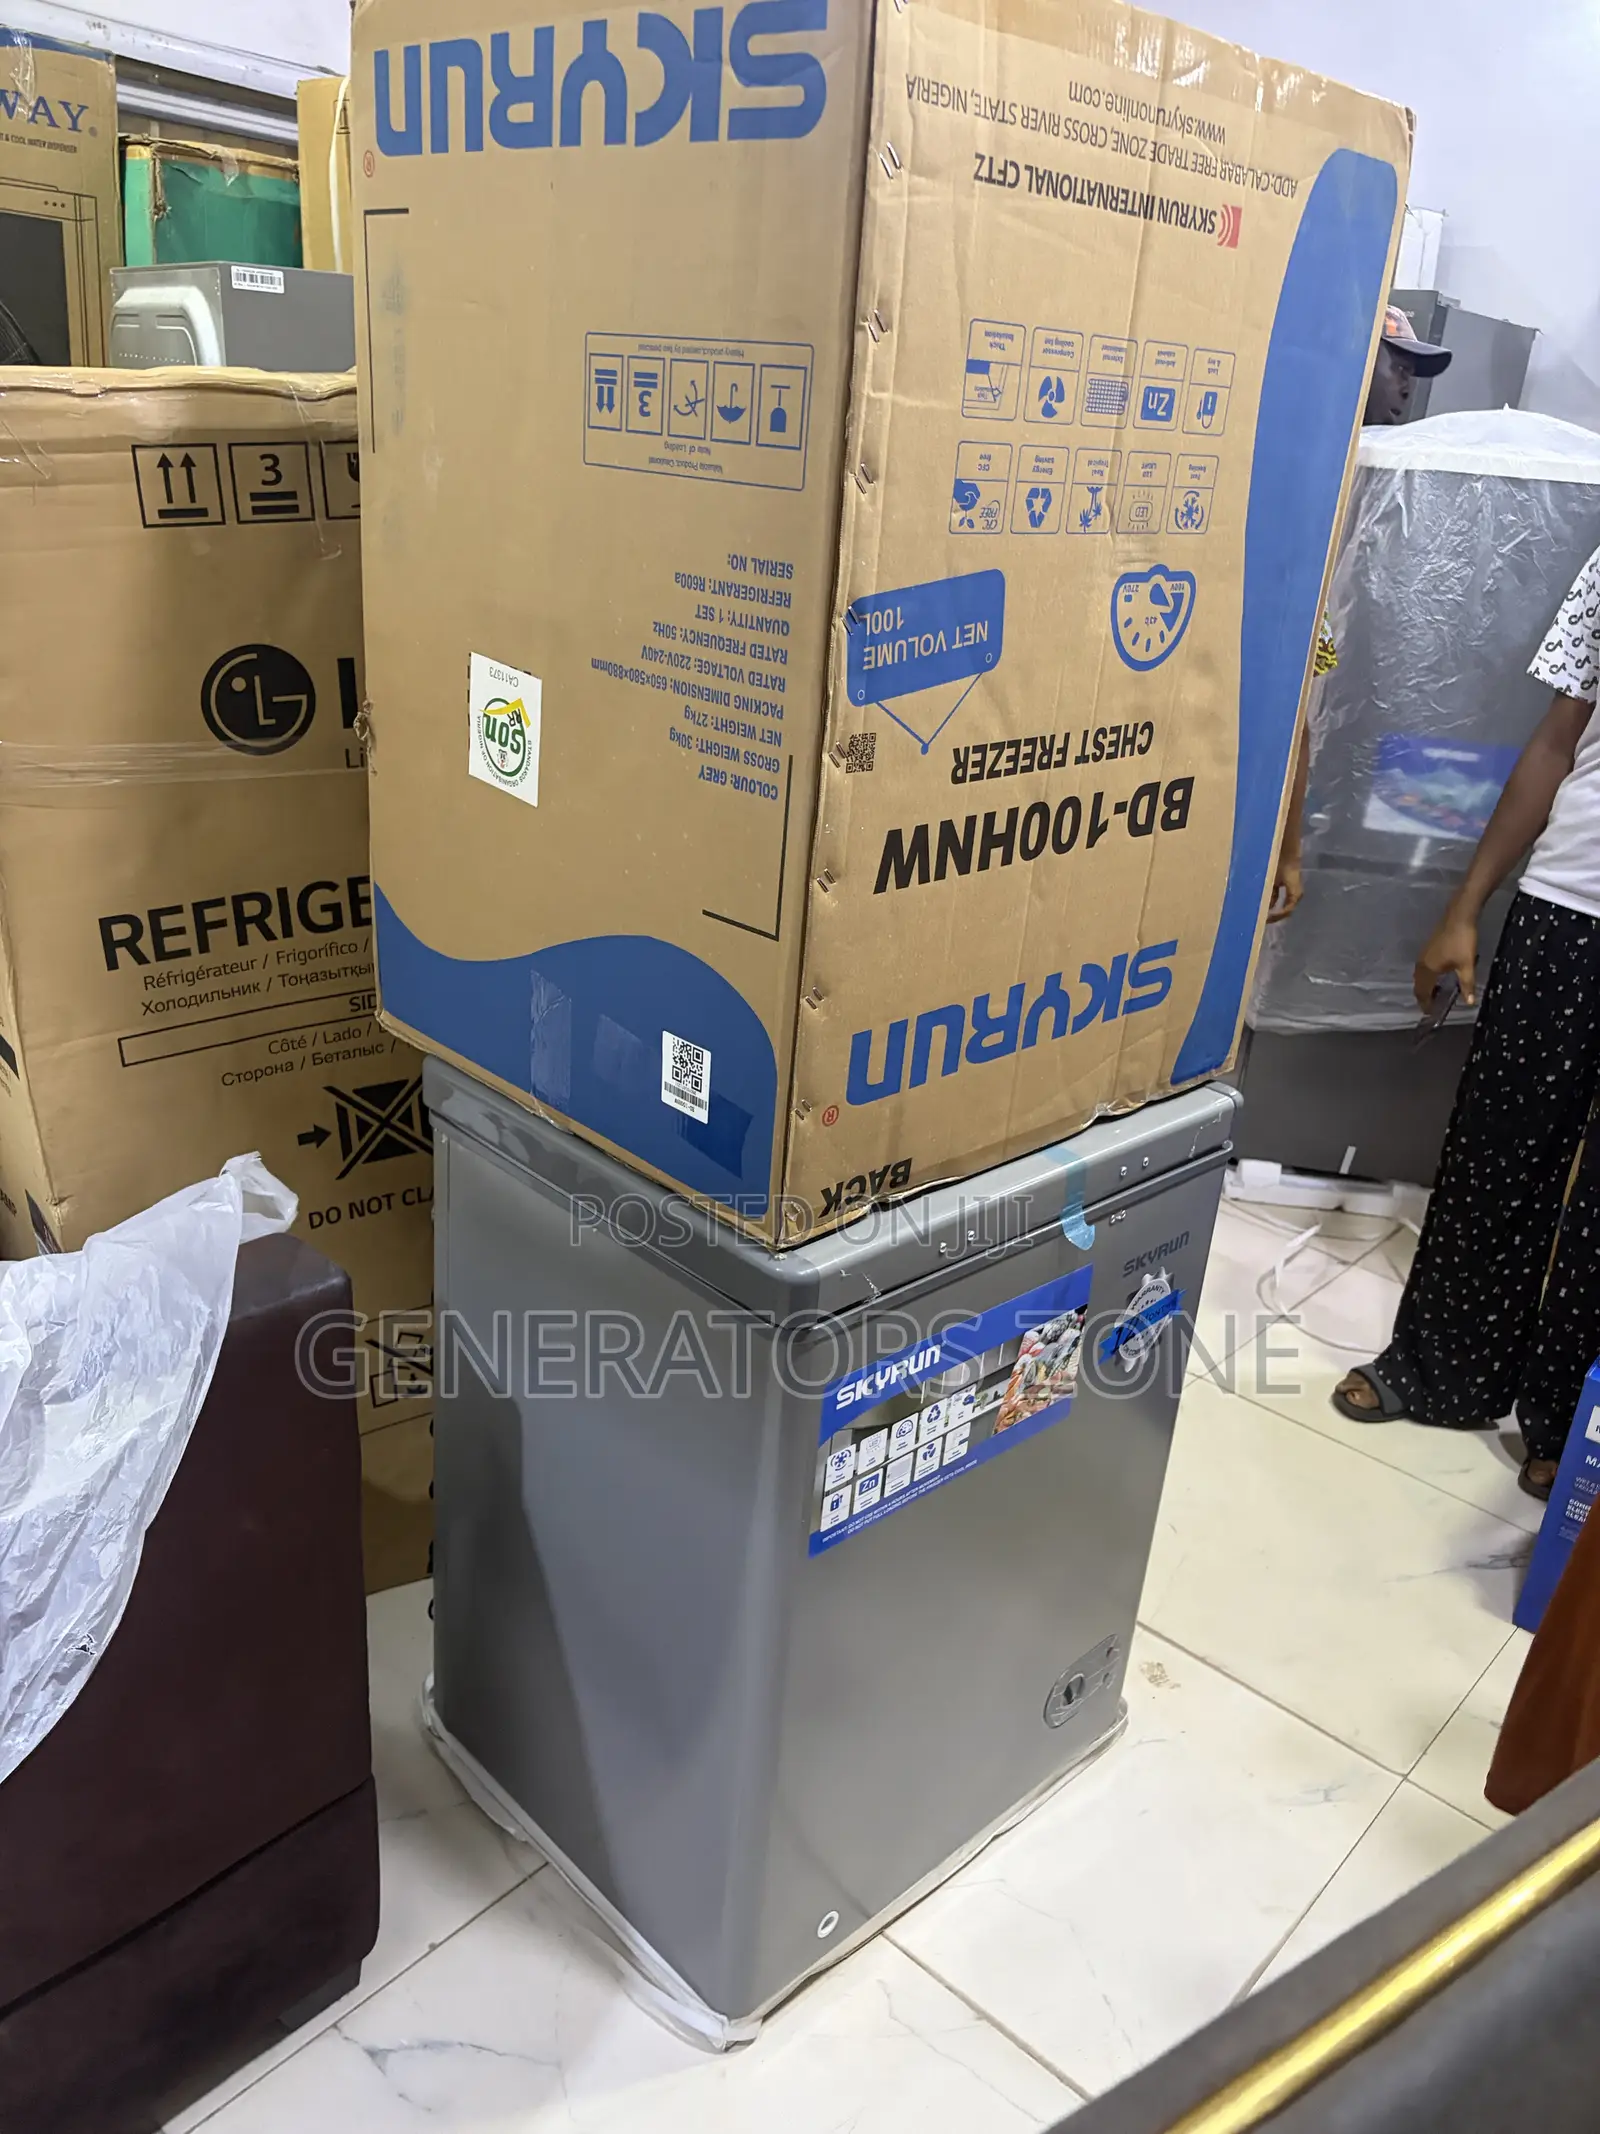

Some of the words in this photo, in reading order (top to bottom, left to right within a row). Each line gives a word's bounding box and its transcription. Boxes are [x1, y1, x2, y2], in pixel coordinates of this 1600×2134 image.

[374, 0, 828, 157] SKYRUN
[905, 73, 968, 115] NIGERIA
[970, 88, 1018, 125] STATE,
[1019, 105, 1061, 138] RIVER
[1068, 80, 1227, 148] www.skyrunonline.com
[1063, 117, 1108, 149] CROSS
[1110, 127, 1148, 160] ZONE,
[1149, 140, 1189, 172] TRADE
[1191, 151, 1218, 178] FREE
[973, 152, 1020, 190] CFTZ
[1024, 163, 1156, 221] INTERNATIONAL
[1157, 196, 1218, 235] SKYRUN
[638, 391, 652, 418] 3
[1148, 392, 1170, 416] Zn
[259, 453, 283, 486] 3
[977, 463, 990, 471] CFC
[1032, 465, 1054, 476] Energy
[1034, 454, 1055, 464] saving
[979, 507, 998, 518] FREE
[982, 519, 998, 530] CFC
[1134, 506, 1149, 518] LED
[727, 553, 747, 572] NO:
[750, 557, 794, 580] SERIAL
[674, 571, 706, 592] R600a
[708, 578, 792, 609] REFRIGERANT:
[695, 604, 715, 622] SET
[727, 610, 790, 636] QUANTITY:
[857, 605, 905, 635] 100L
[652, 621, 677, 641] 50Hz
[679, 627, 746, 656] FREQUENCY:
[951, 619, 988, 649] NET
[640, 644, 691, 671] 220V-240V
[749, 643, 788, 665] RATED
[863, 631, 947, 670] VOLUME
[489, 666, 519, 688] CA11373
[694, 657, 744, 684] VOLTAGE:
[748, 670, 786, 693] RATED
[670, 678, 730, 707] DIMENSION:
[684, 704, 708, 727] 27kg
[733, 695, 784, 720] PACKING
[669, 727, 693, 750] 30kg
[710, 715, 756, 740] WEIGHT:
[759, 728, 782, 747] NET
[695, 737, 740, 762] WEIGHT:
[1074, 720, 1155, 766] CHEST
[743, 750, 780, 773] GROSS
[950, 732, 1070, 785] FREEZER
[698, 764, 727, 786] GREY
[730, 773, 778, 801] COLOUR:
[873, 776, 1195, 895] BD-100HNW
[98, 876, 373, 971] REFRIGE
[144, 957, 258, 991] Réfrigérateur
[276, 941, 358, 966] Frigorífico
[141, 982, 261, 1017] Холодильник
[845, 939, 1179, 1106] SKYRUN
[268, 1035, 307, 1055] Côté
[323, 1026, 361, 1045] Lado
[221, 1059, 294, 1087] Сторона
[818, 1157, 913, 1219] BACK
[308, 1206, 342, 1230] DO
[348, 1192, 396, 1220] NOT
[1122, 1230, 1190, 1278] SKYRUN
[1131, 1285, 1165, 1310] WARRANTY
[836, 1344, 941, 1411] SKYRUN
[861, 1479, 876, 1492] Zn
